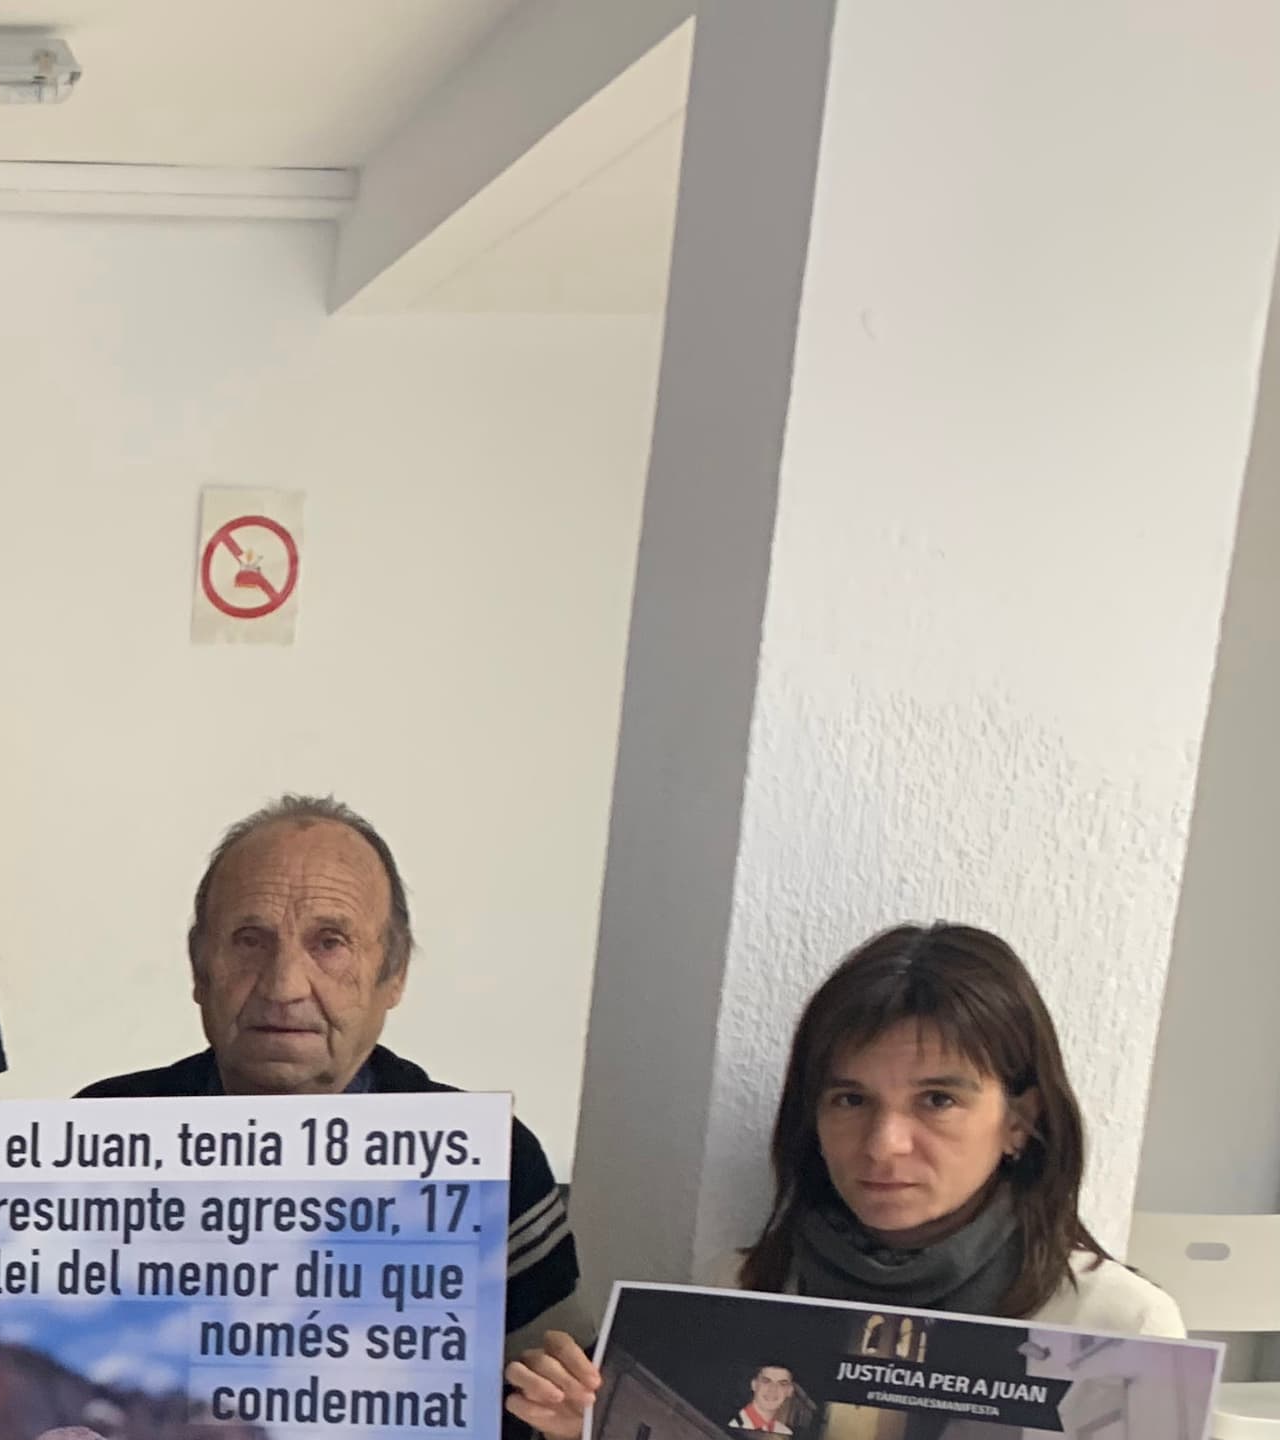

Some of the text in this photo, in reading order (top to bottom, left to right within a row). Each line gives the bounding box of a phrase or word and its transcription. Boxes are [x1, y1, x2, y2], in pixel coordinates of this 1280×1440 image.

[6, 1122, 42, 1169] el
[52, 1121, 163, 1171] Juan,
[178, 1119, 282, 1168] tenia
[301, 1118, 348, 1167] 18
[364, 1128, 481, 1178] anys.
[201, 1194, 402, 1244] agressor,
[419, 1184, 482, 1234] 17.
[58, 1250, 121, 1296] del
[138, 1263, 278, 1298] menor
[295, 1250, 361, 1298] diu
[382, 1263, 463, 1311] que
[200, 1310, 468, 1362] només serà
[211, 1376, 468, 1428] condemnat
[837, 1362, 1048, 1404] JUSTÍCIA PER A JUAN
